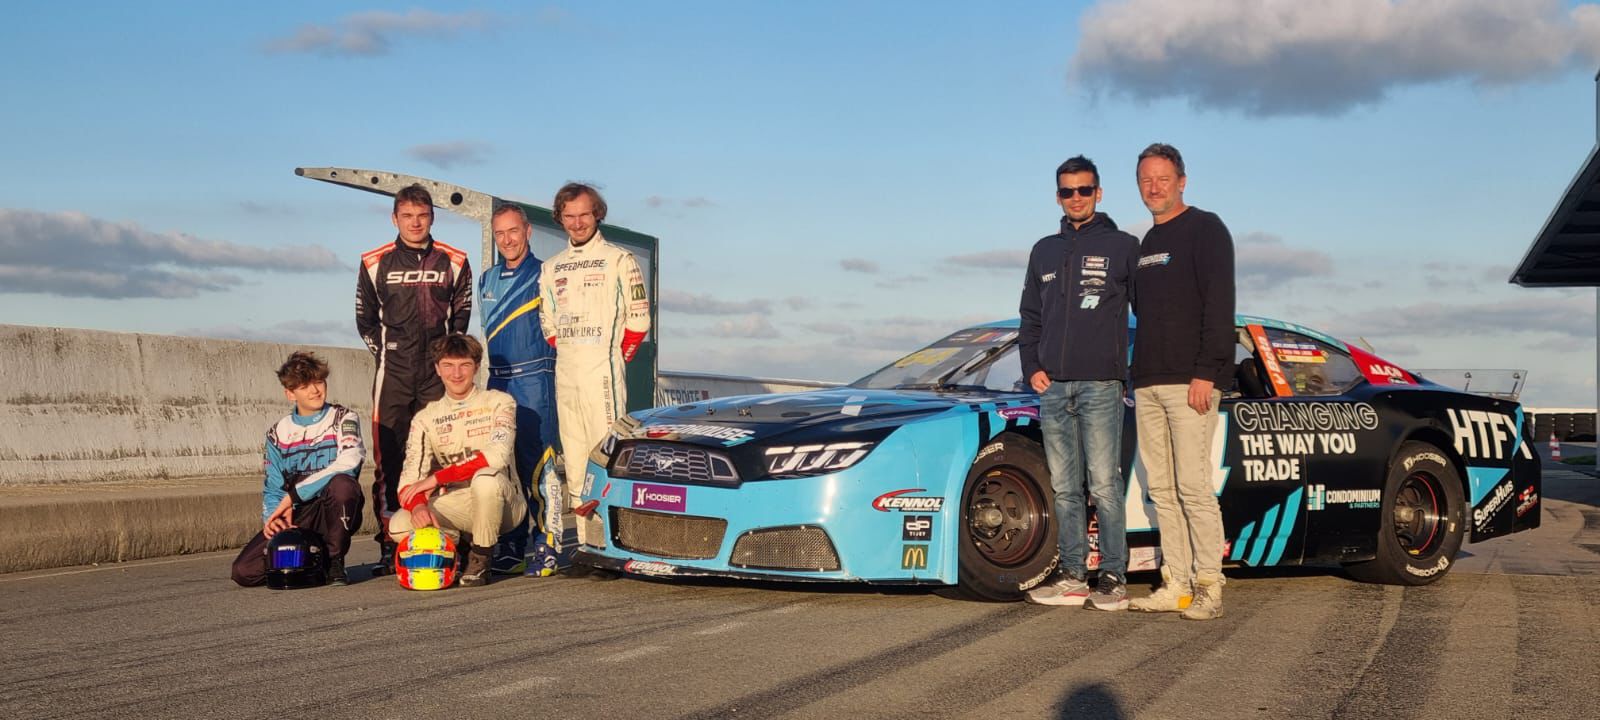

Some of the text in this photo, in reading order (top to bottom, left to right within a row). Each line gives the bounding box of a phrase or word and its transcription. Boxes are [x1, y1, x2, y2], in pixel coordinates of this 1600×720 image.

[386, 270, 446, 284] SODI
[1233, 402, 1379, 432] CHANGING
[1239, 433, 1357, 456] THE WAY YOU
[1243, 459, 1300, 482] TRADE
[645, 493, 682, 505] HOOSIER
[879, 497, 942, 508] KENNOL
[1326, 489, 1381, 503] CONDOMINIUM
[627, 561, 676, 575] KENNOL
